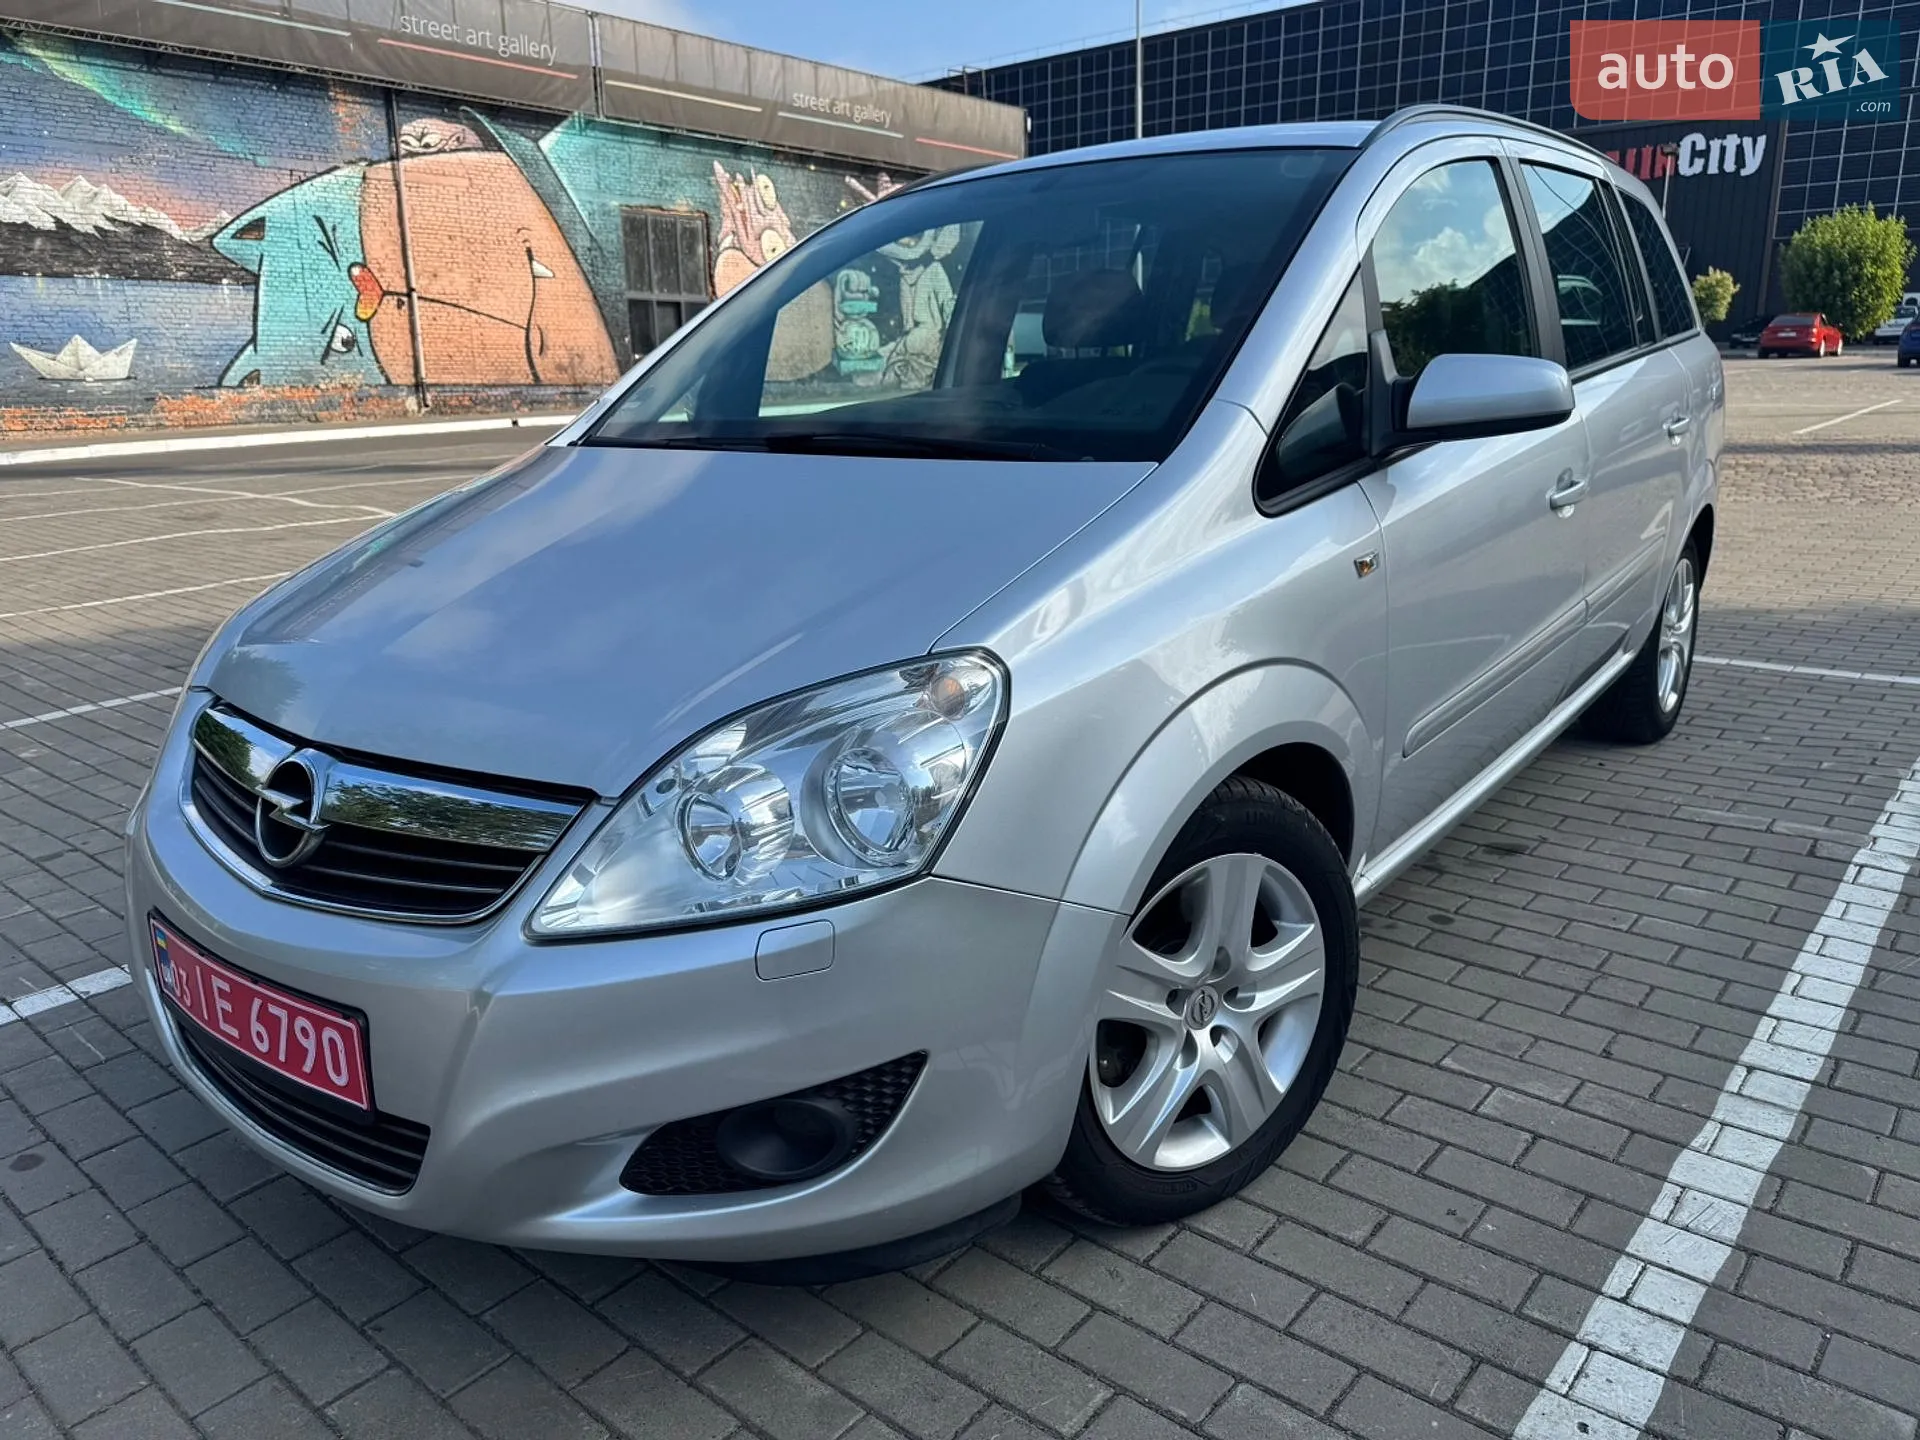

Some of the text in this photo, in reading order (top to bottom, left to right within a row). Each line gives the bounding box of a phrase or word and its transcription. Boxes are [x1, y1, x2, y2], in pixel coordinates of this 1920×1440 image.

[400, 15, 557, 66] street art gallery
[792, 92, 892, 128] street art gallery
[170, 959, 192, 1008] 03
[250, 996, 349, 1088] 6790
